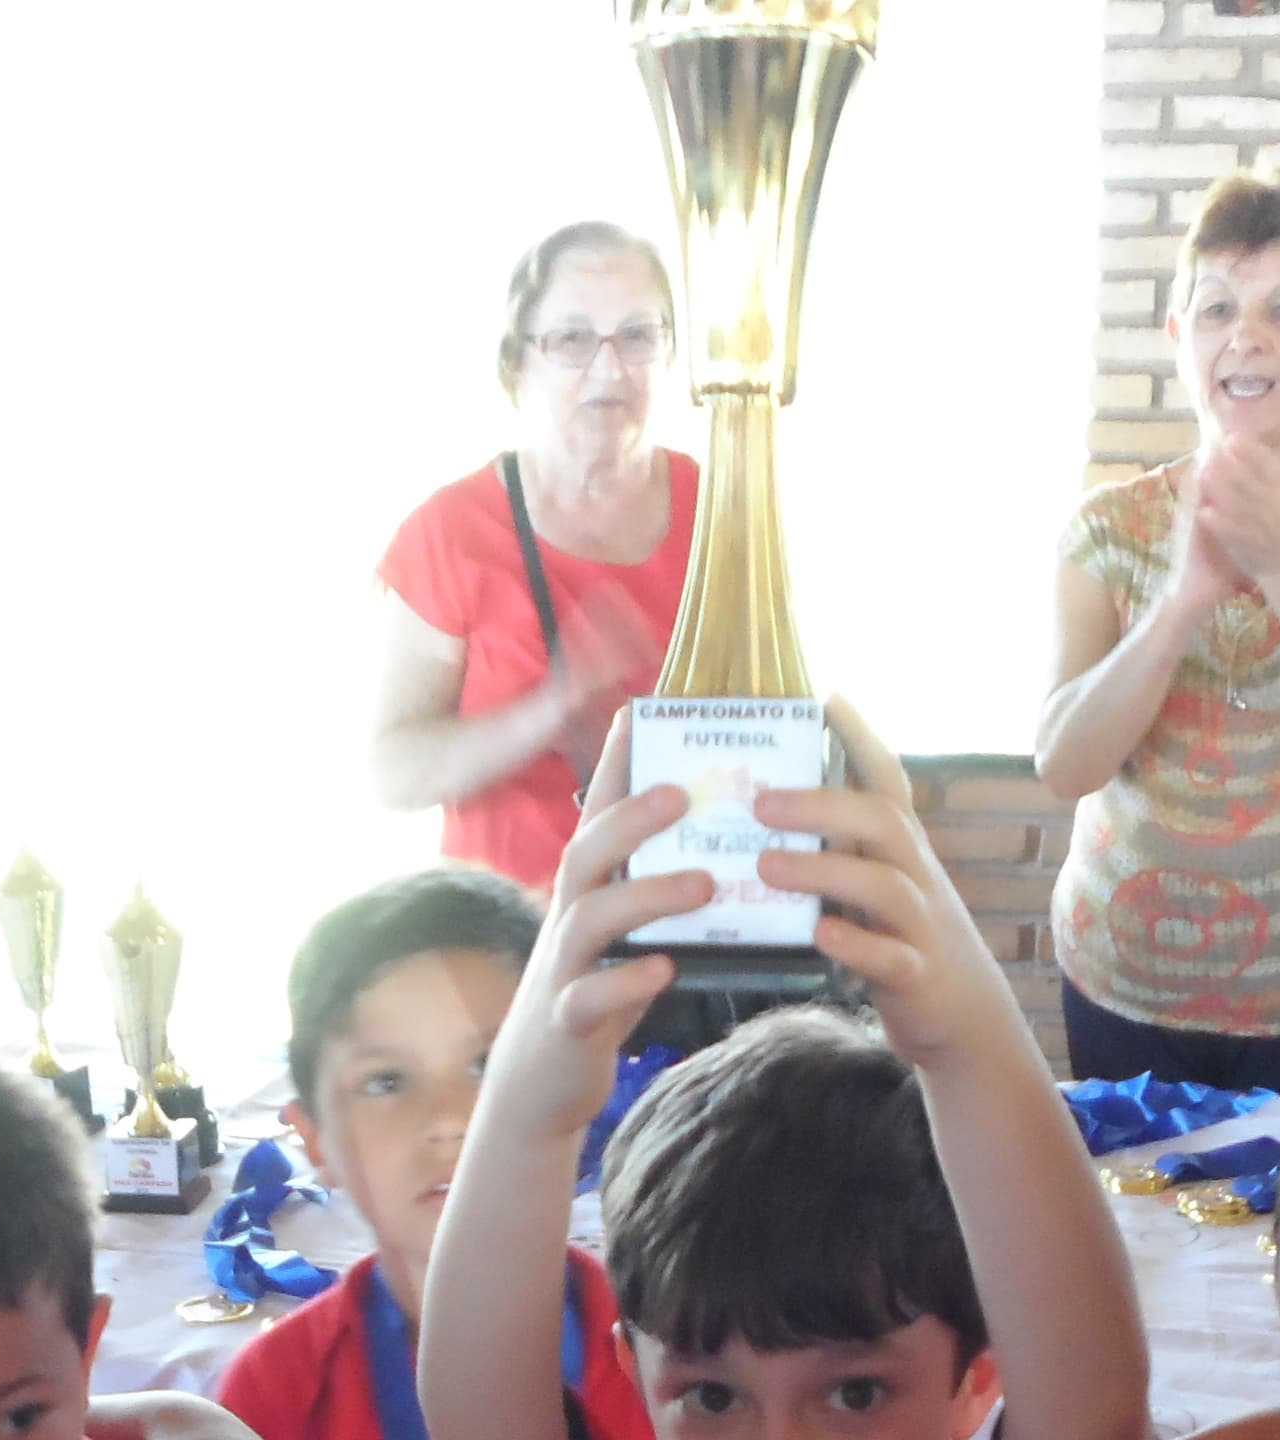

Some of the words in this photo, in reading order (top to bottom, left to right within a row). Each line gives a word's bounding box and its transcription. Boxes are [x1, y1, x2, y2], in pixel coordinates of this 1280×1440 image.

[639, 704, 784, 721] CAMPEONATO
[791, 704, 818, 721] DE
[683, 731, 779, 749] FUTEBOL
